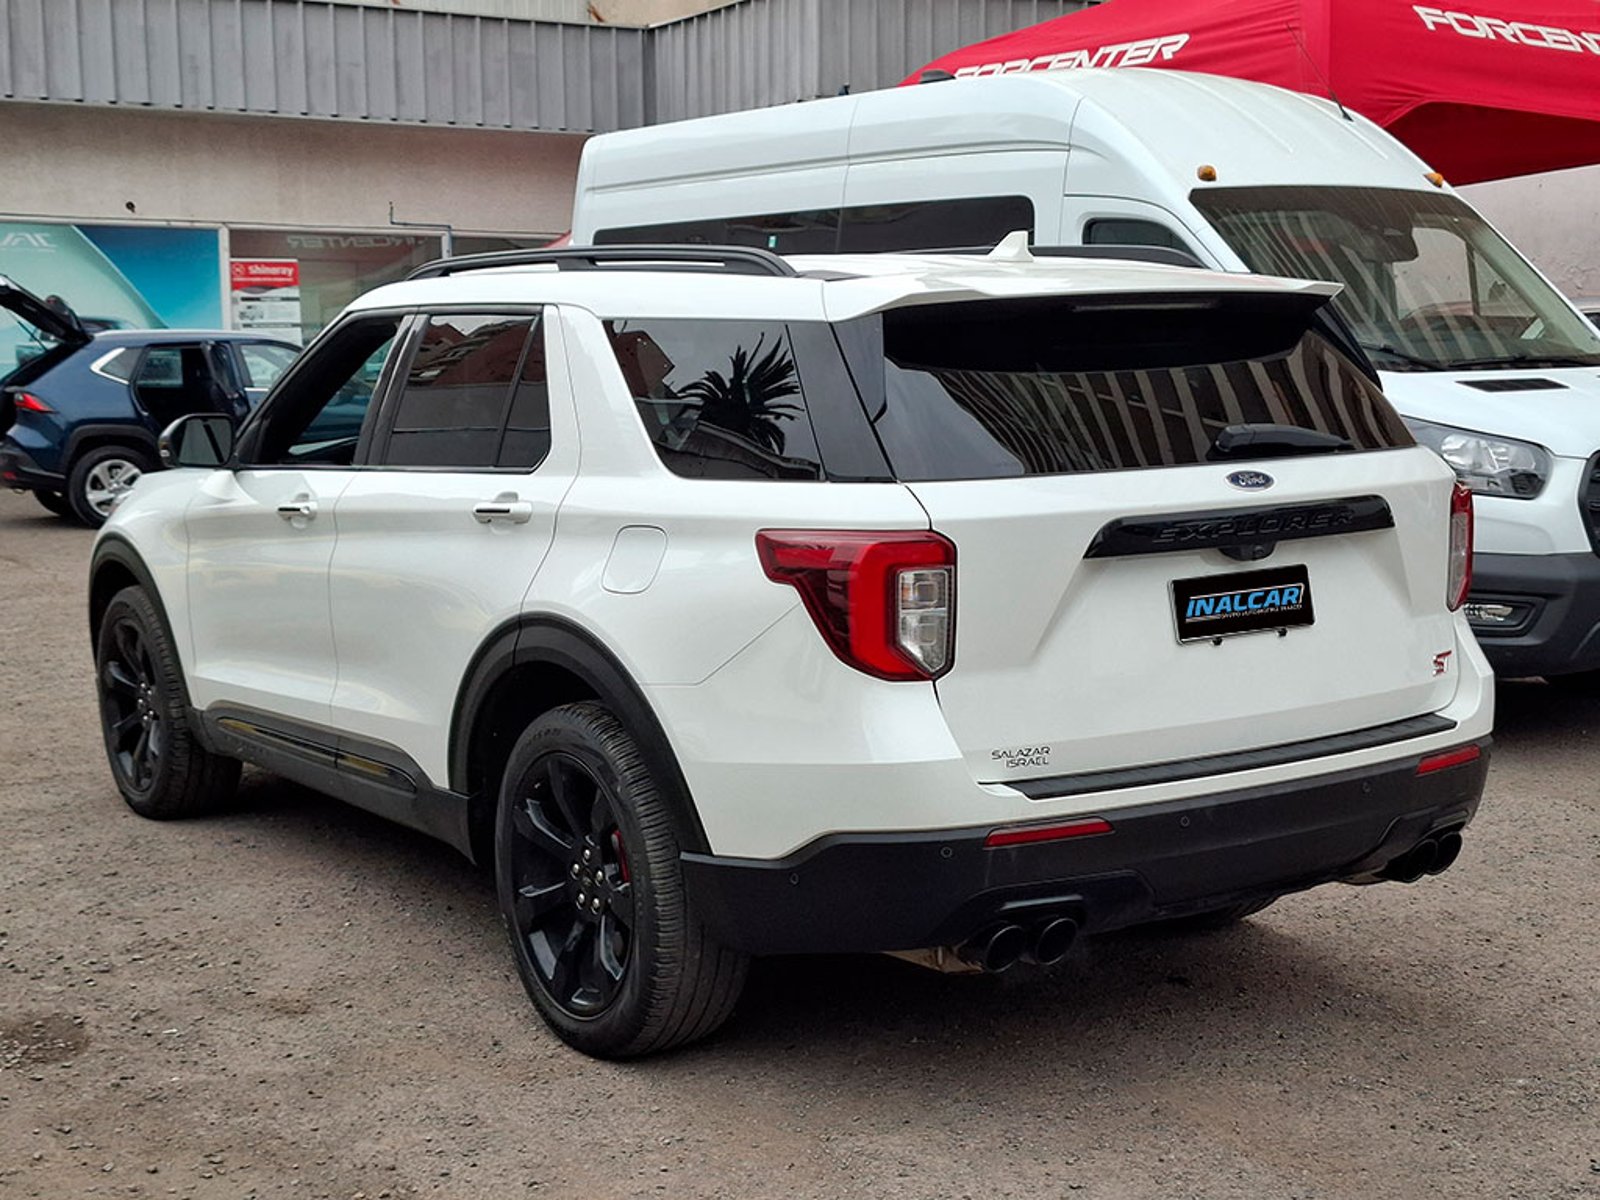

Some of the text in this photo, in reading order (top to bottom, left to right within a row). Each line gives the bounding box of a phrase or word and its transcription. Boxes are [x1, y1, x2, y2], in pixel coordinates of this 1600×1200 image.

[1412, 5, 1600, 55] FORCEN
[1153, 508, 1355, 543] EXPLORER
[1185, 587, 1300, 617] INALCAR
[1432, 650, 1452, 677] ST
[991, 746, 1051, 760] SALAZAR
[1005, 756, 1049, 768] ISRAEL
